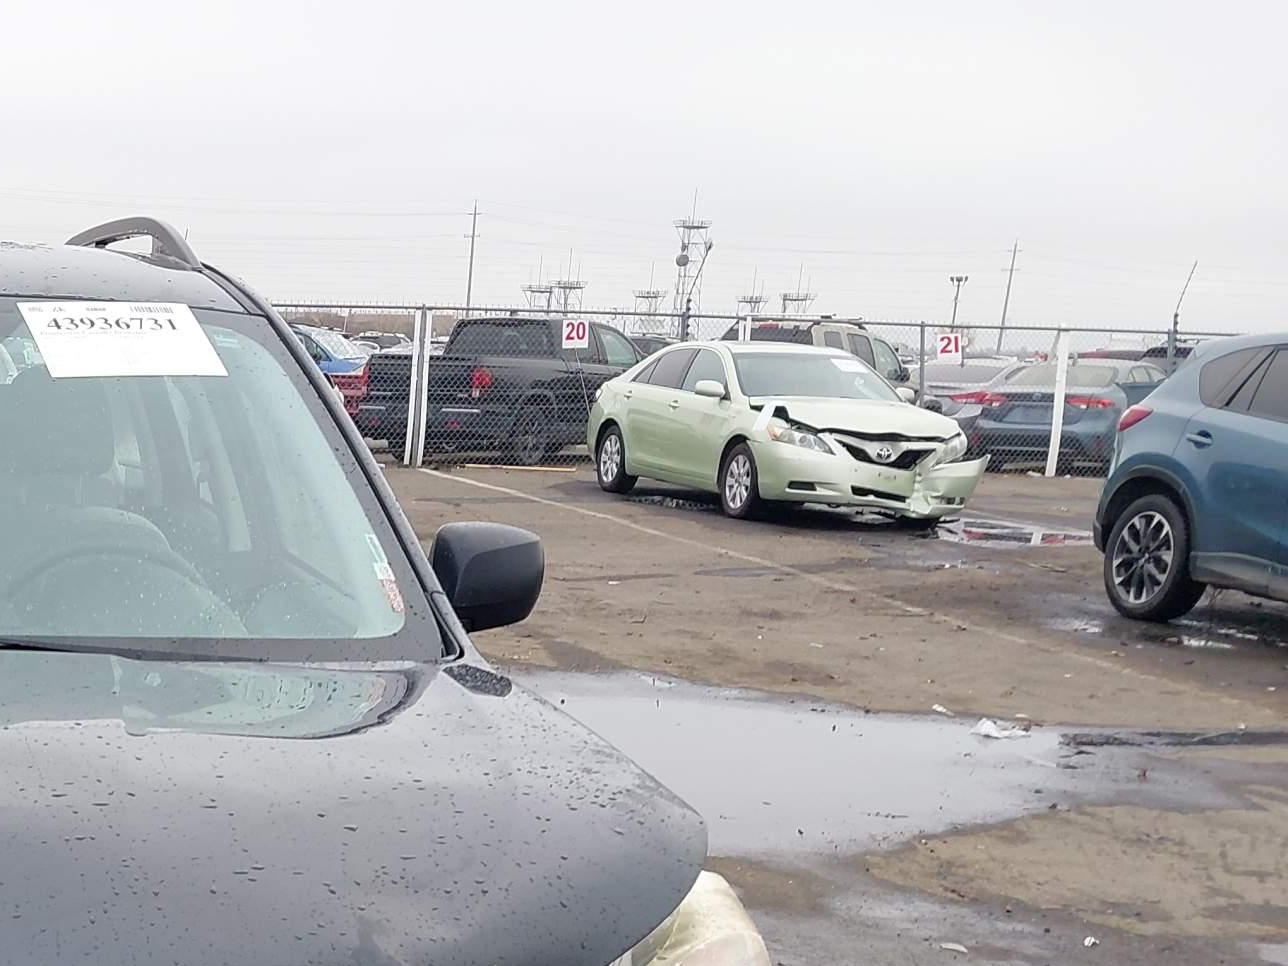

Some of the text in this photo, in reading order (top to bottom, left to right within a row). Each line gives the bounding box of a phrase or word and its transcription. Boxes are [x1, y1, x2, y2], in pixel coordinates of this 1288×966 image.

[46, 317, 177, 331] 43936731
[565, 321, 586, 341] 20
[940, 335, 960, 353] 21
